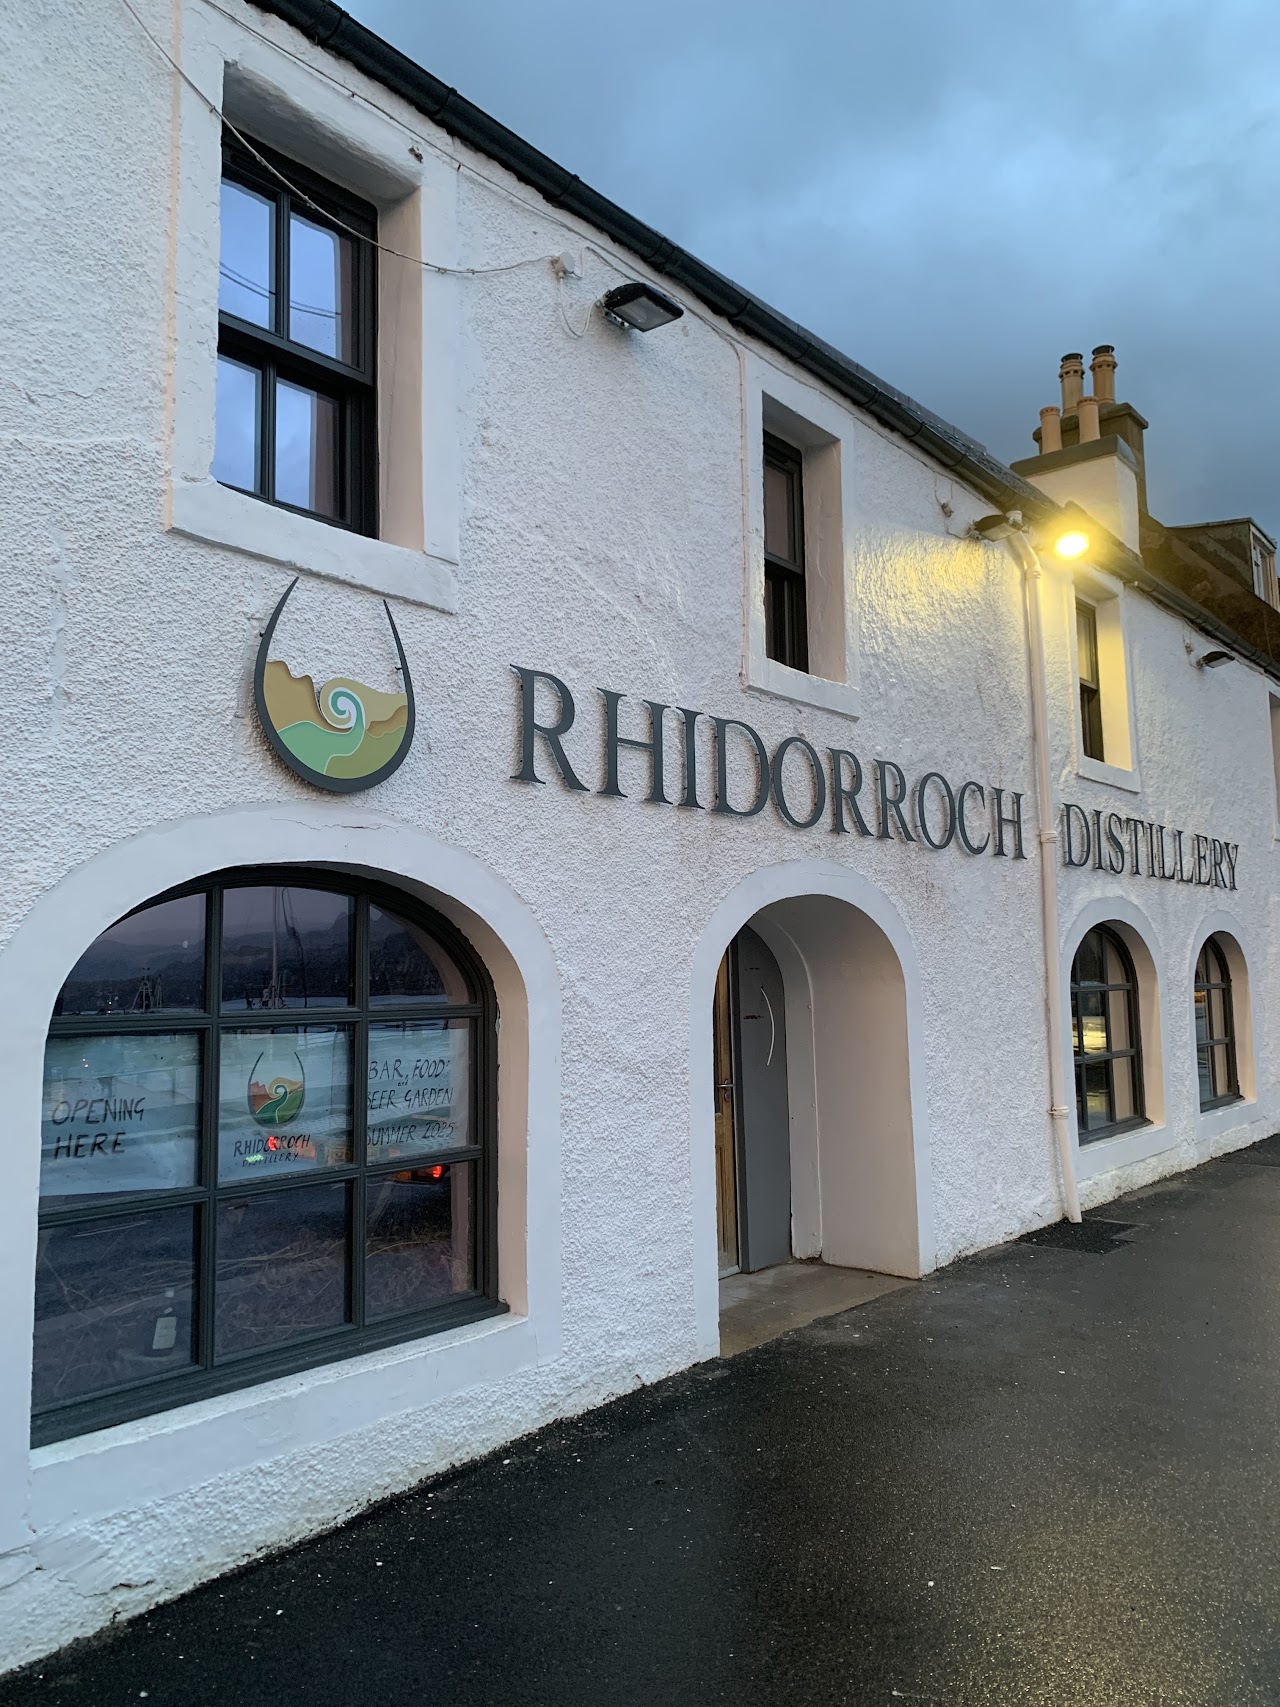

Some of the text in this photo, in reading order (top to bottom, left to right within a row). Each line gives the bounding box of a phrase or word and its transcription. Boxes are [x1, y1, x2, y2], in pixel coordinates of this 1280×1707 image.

[510, 663, 1239, 891] RHIDORROCH DISTILLERY
[51, 1097, 146, 1126] OPENING
[404, 1087, 454, 1109] GARDEN
[422, 1121, 455, 1139] 2025
[54, 1131, 126, 1159] HERE
